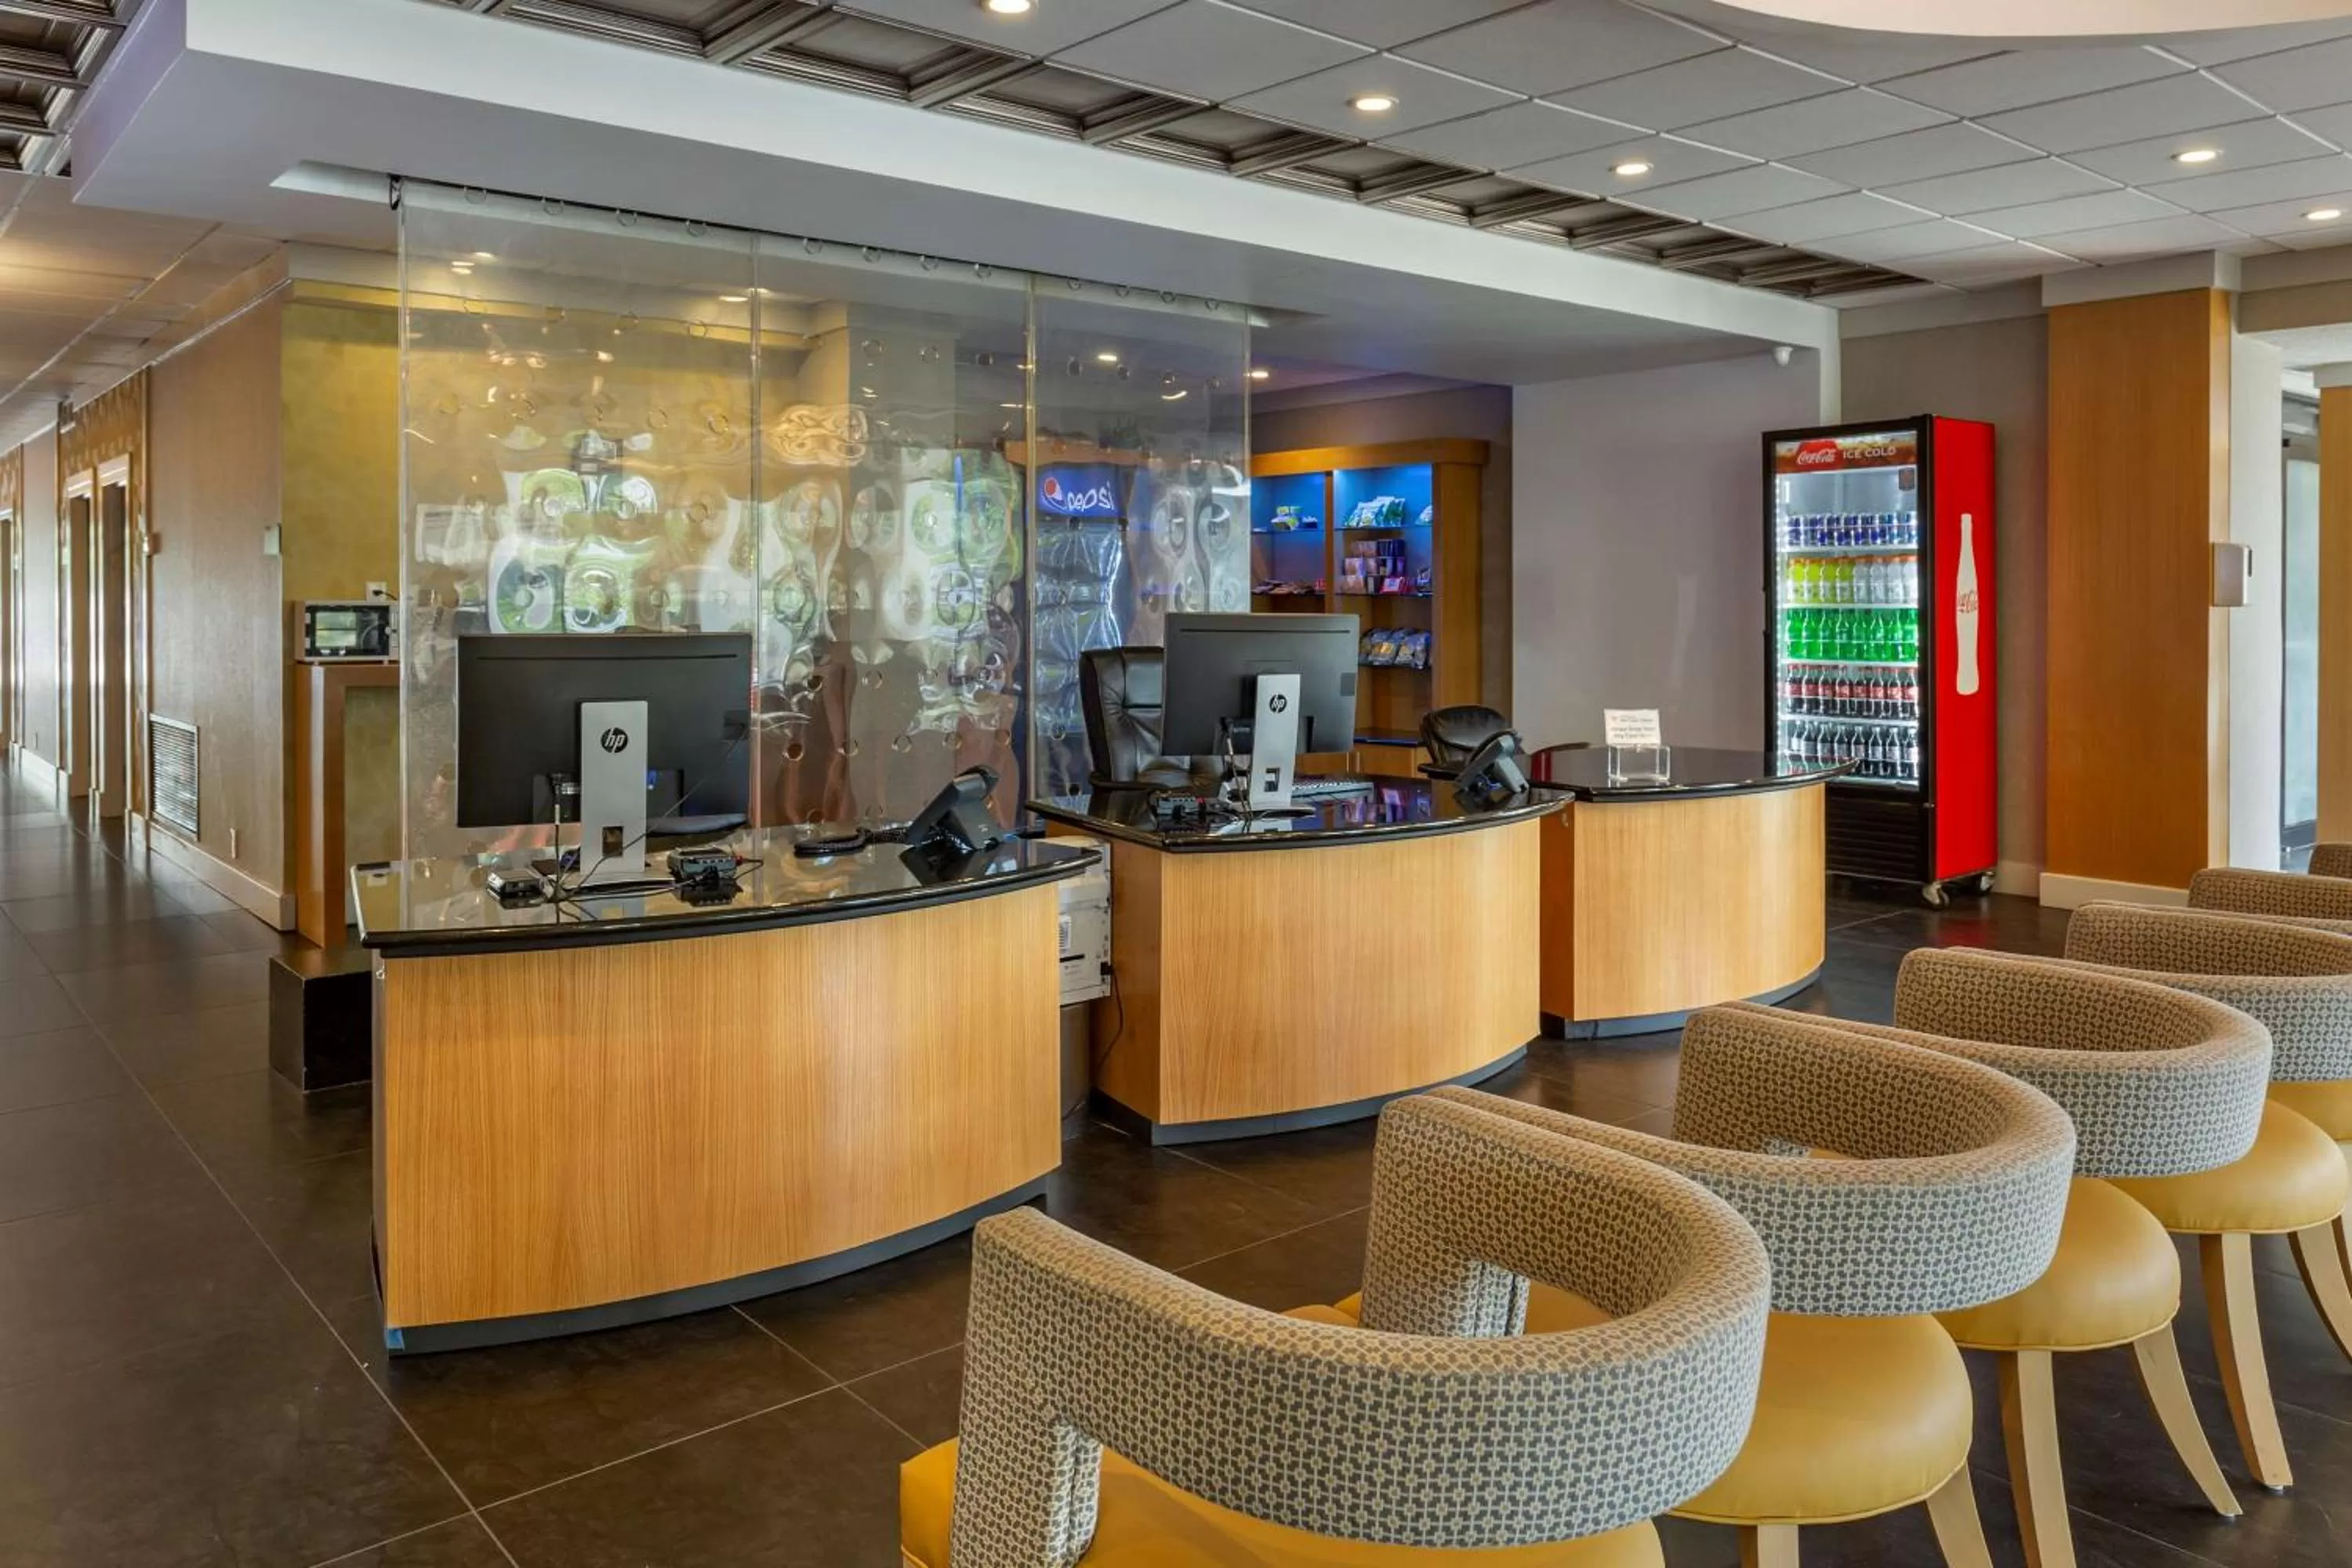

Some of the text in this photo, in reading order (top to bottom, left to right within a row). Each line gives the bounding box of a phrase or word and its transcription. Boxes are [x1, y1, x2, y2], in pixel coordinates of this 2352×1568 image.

[1843, 446, 1896, 459] ICE COLD
[1067, 480, 1115, 513] pepsi
[1270, 693, 1286, 714] hp
[603, 728, 626, 753] hp
